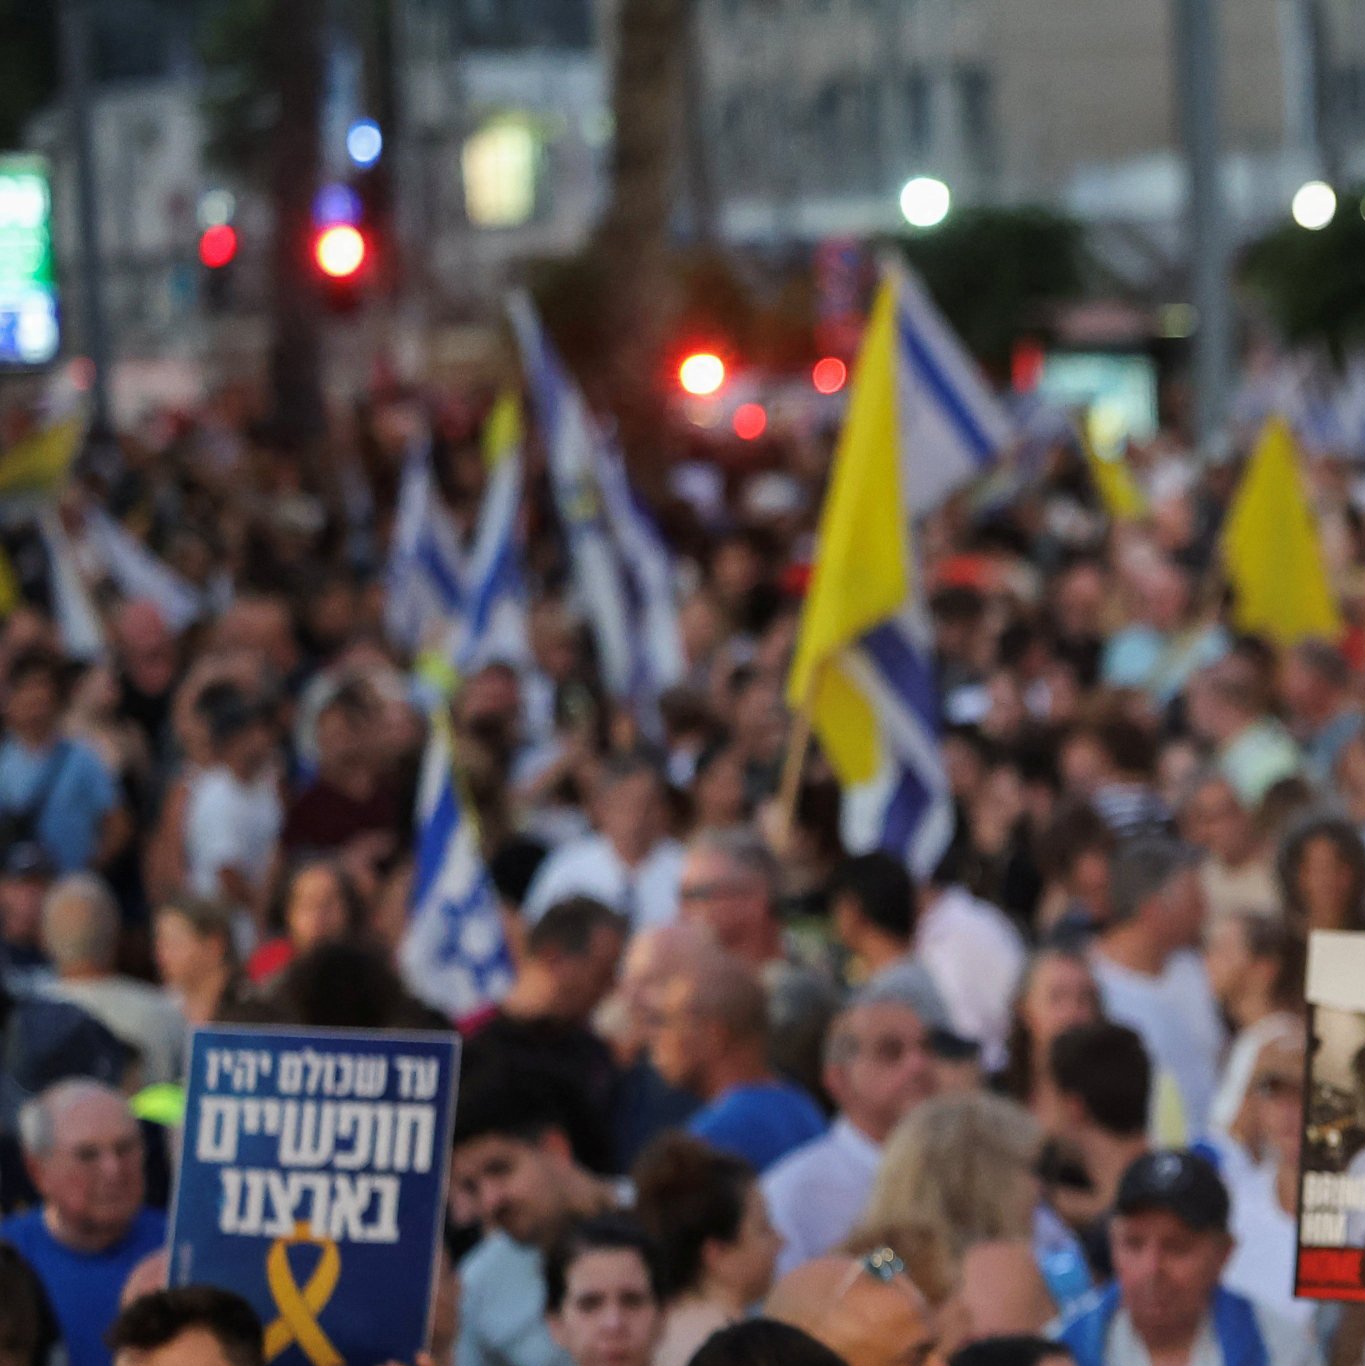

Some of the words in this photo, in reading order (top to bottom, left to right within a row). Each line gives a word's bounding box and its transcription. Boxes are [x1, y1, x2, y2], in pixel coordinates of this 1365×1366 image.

[395, 1056, 440, 1100] עד
[196, 1097, 437, 1173] חופשיים
[219, 1168, 400, 1243] בארצנו
